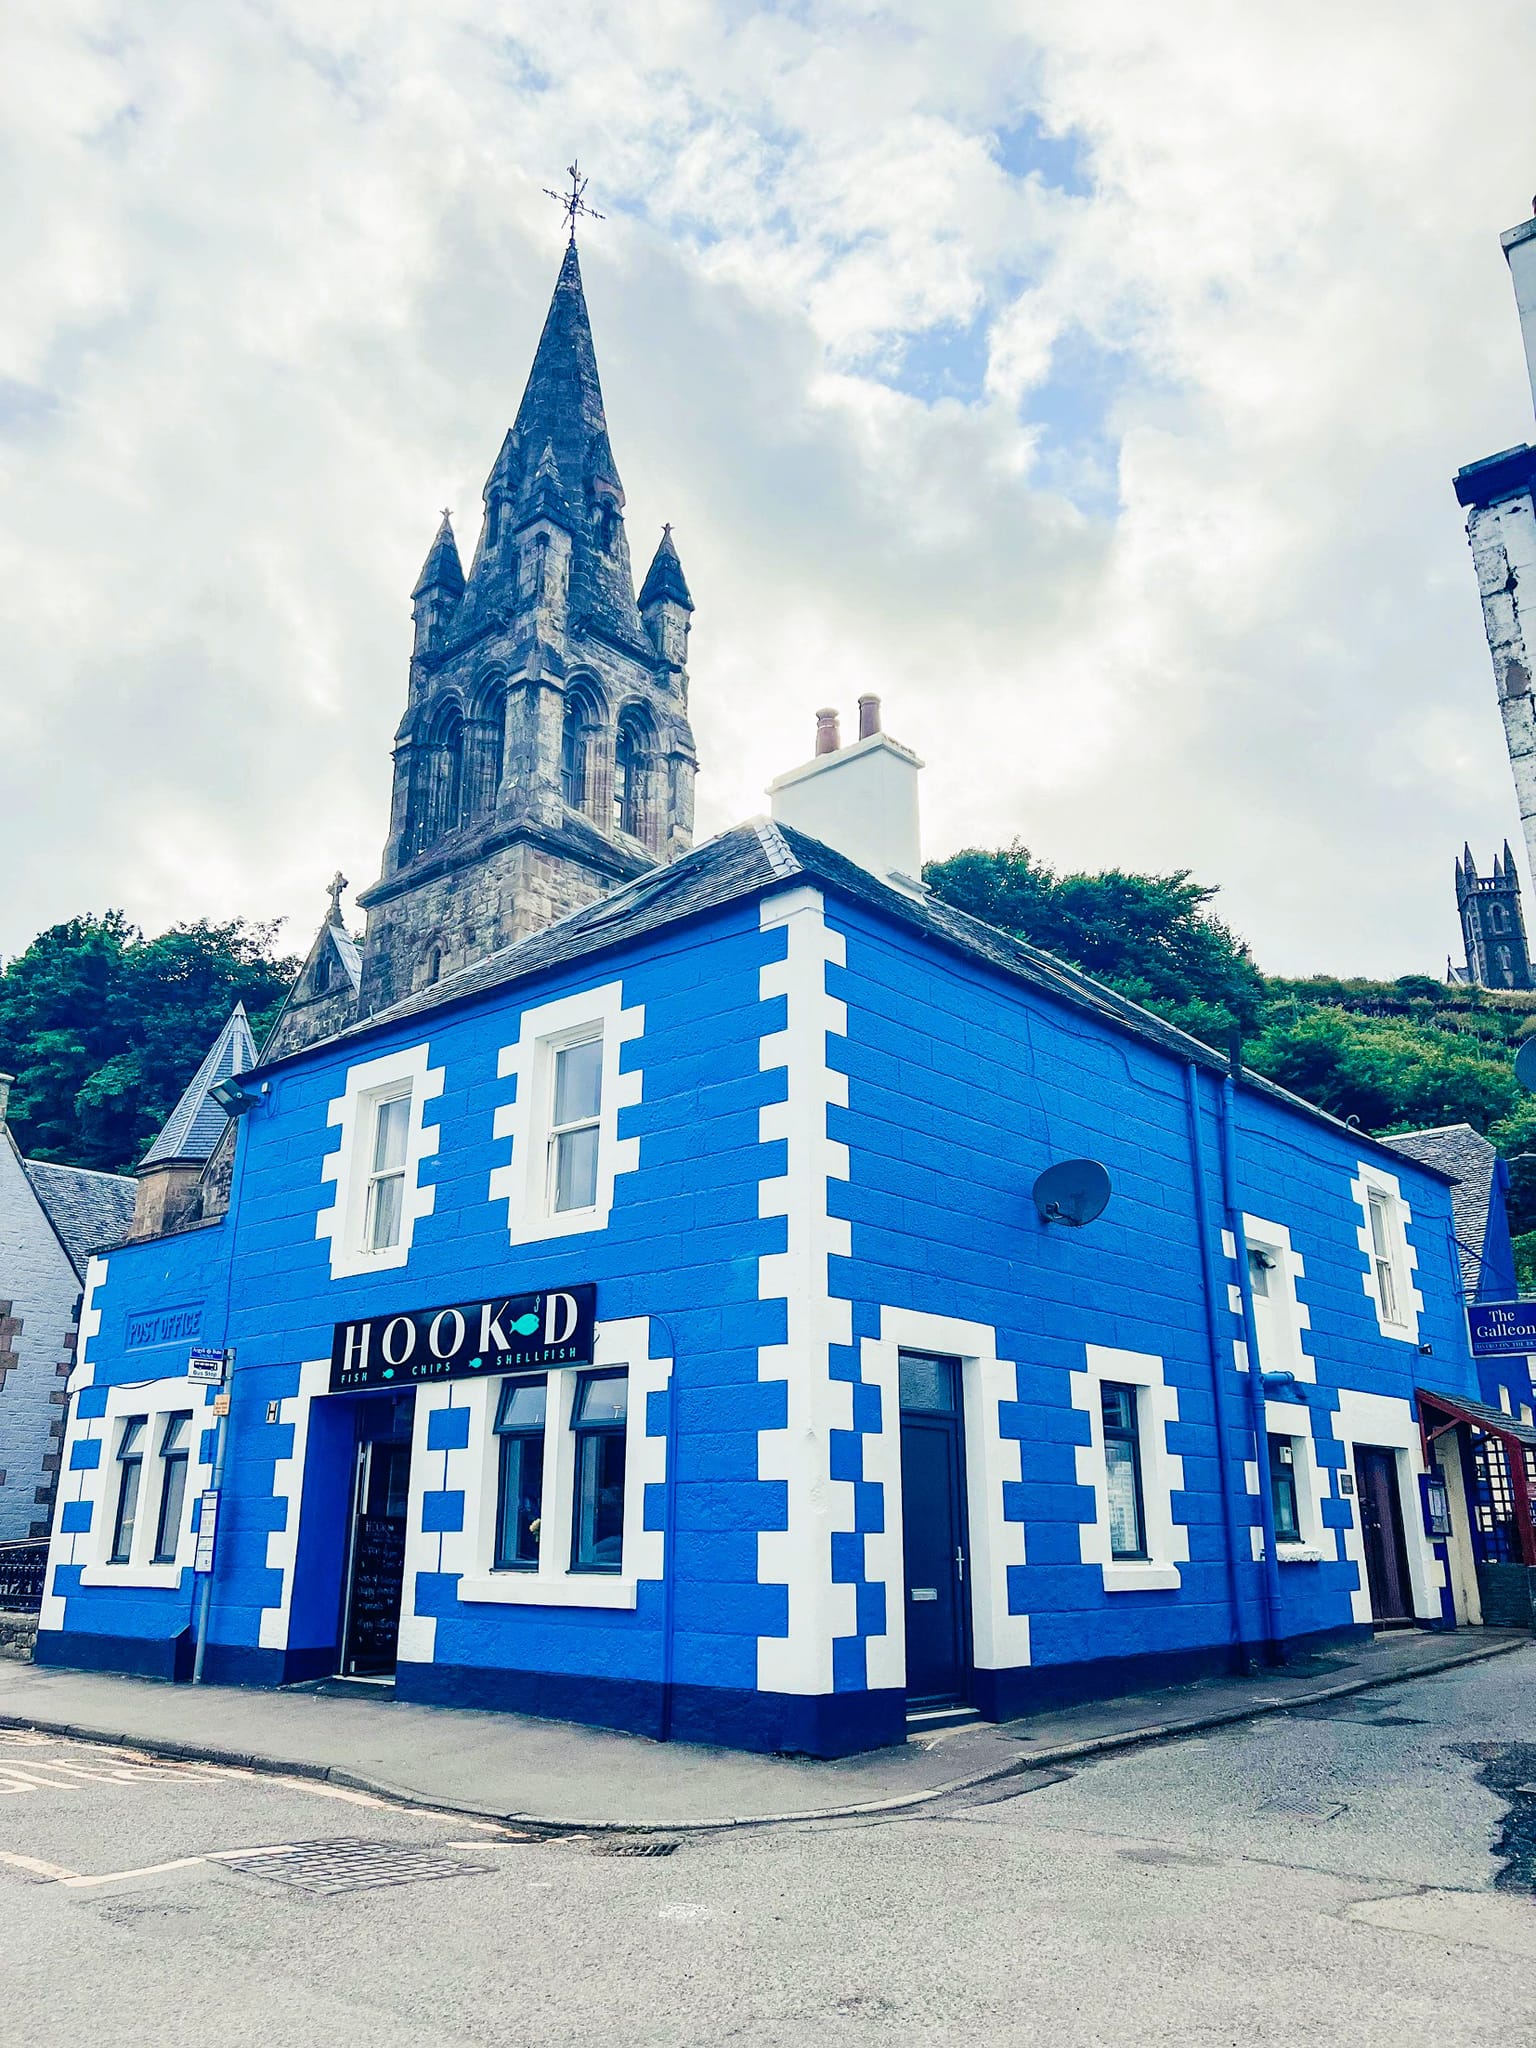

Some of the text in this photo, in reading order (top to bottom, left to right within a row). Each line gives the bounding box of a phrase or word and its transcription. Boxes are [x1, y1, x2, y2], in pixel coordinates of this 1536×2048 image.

[1489, 1309, 1515, 1322] The
[129, 1311, 202, 1345] POST OFFICE
[1477, 1324, 1536, 1337] Galleon
[341, 1347, 577, 1384] FISH CHIPS SHELLFISH
[267, 1402, 278, 1421] H
